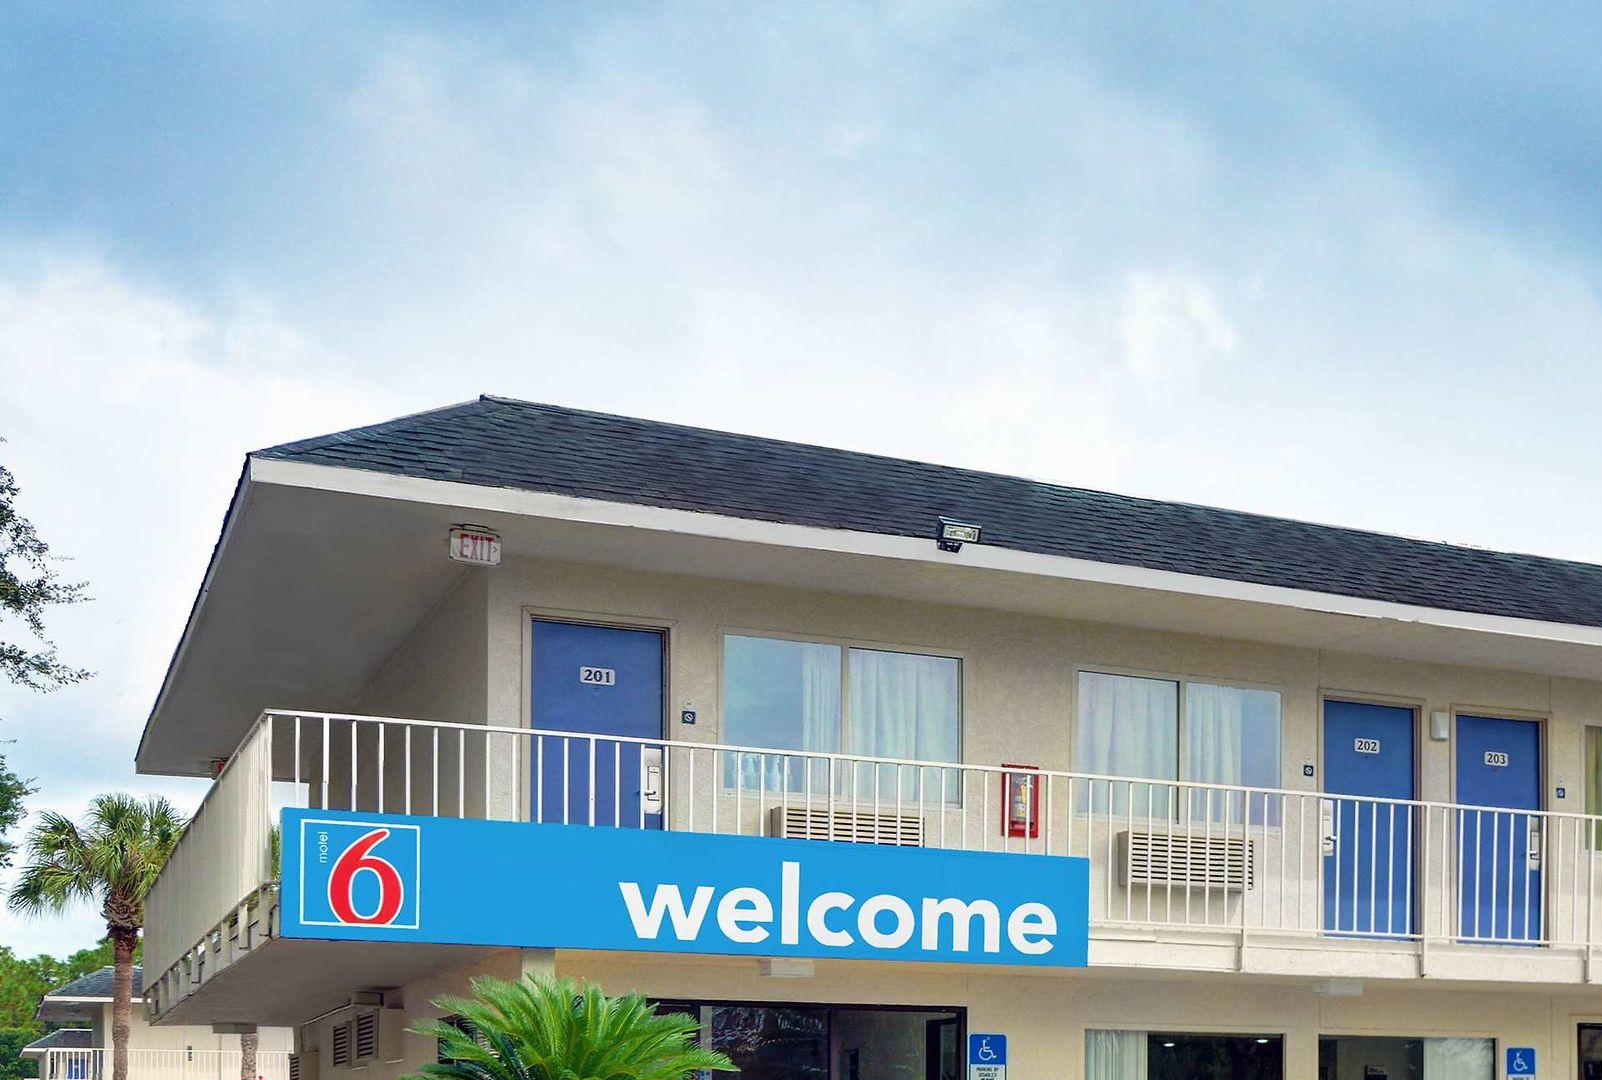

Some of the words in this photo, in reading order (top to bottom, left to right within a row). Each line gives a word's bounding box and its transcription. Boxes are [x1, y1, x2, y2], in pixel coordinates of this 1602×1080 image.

[460, 533, 494, 562] EXIT
[583, 669, 611, 683] 201
[1357, 740, 1377, 752] 202
[1487, 753, 1506, 765] 203
[317, 831, 329, 863] motel
[327, 828, 405, 926] 6
[618, 861, 1058, 955] welcome
